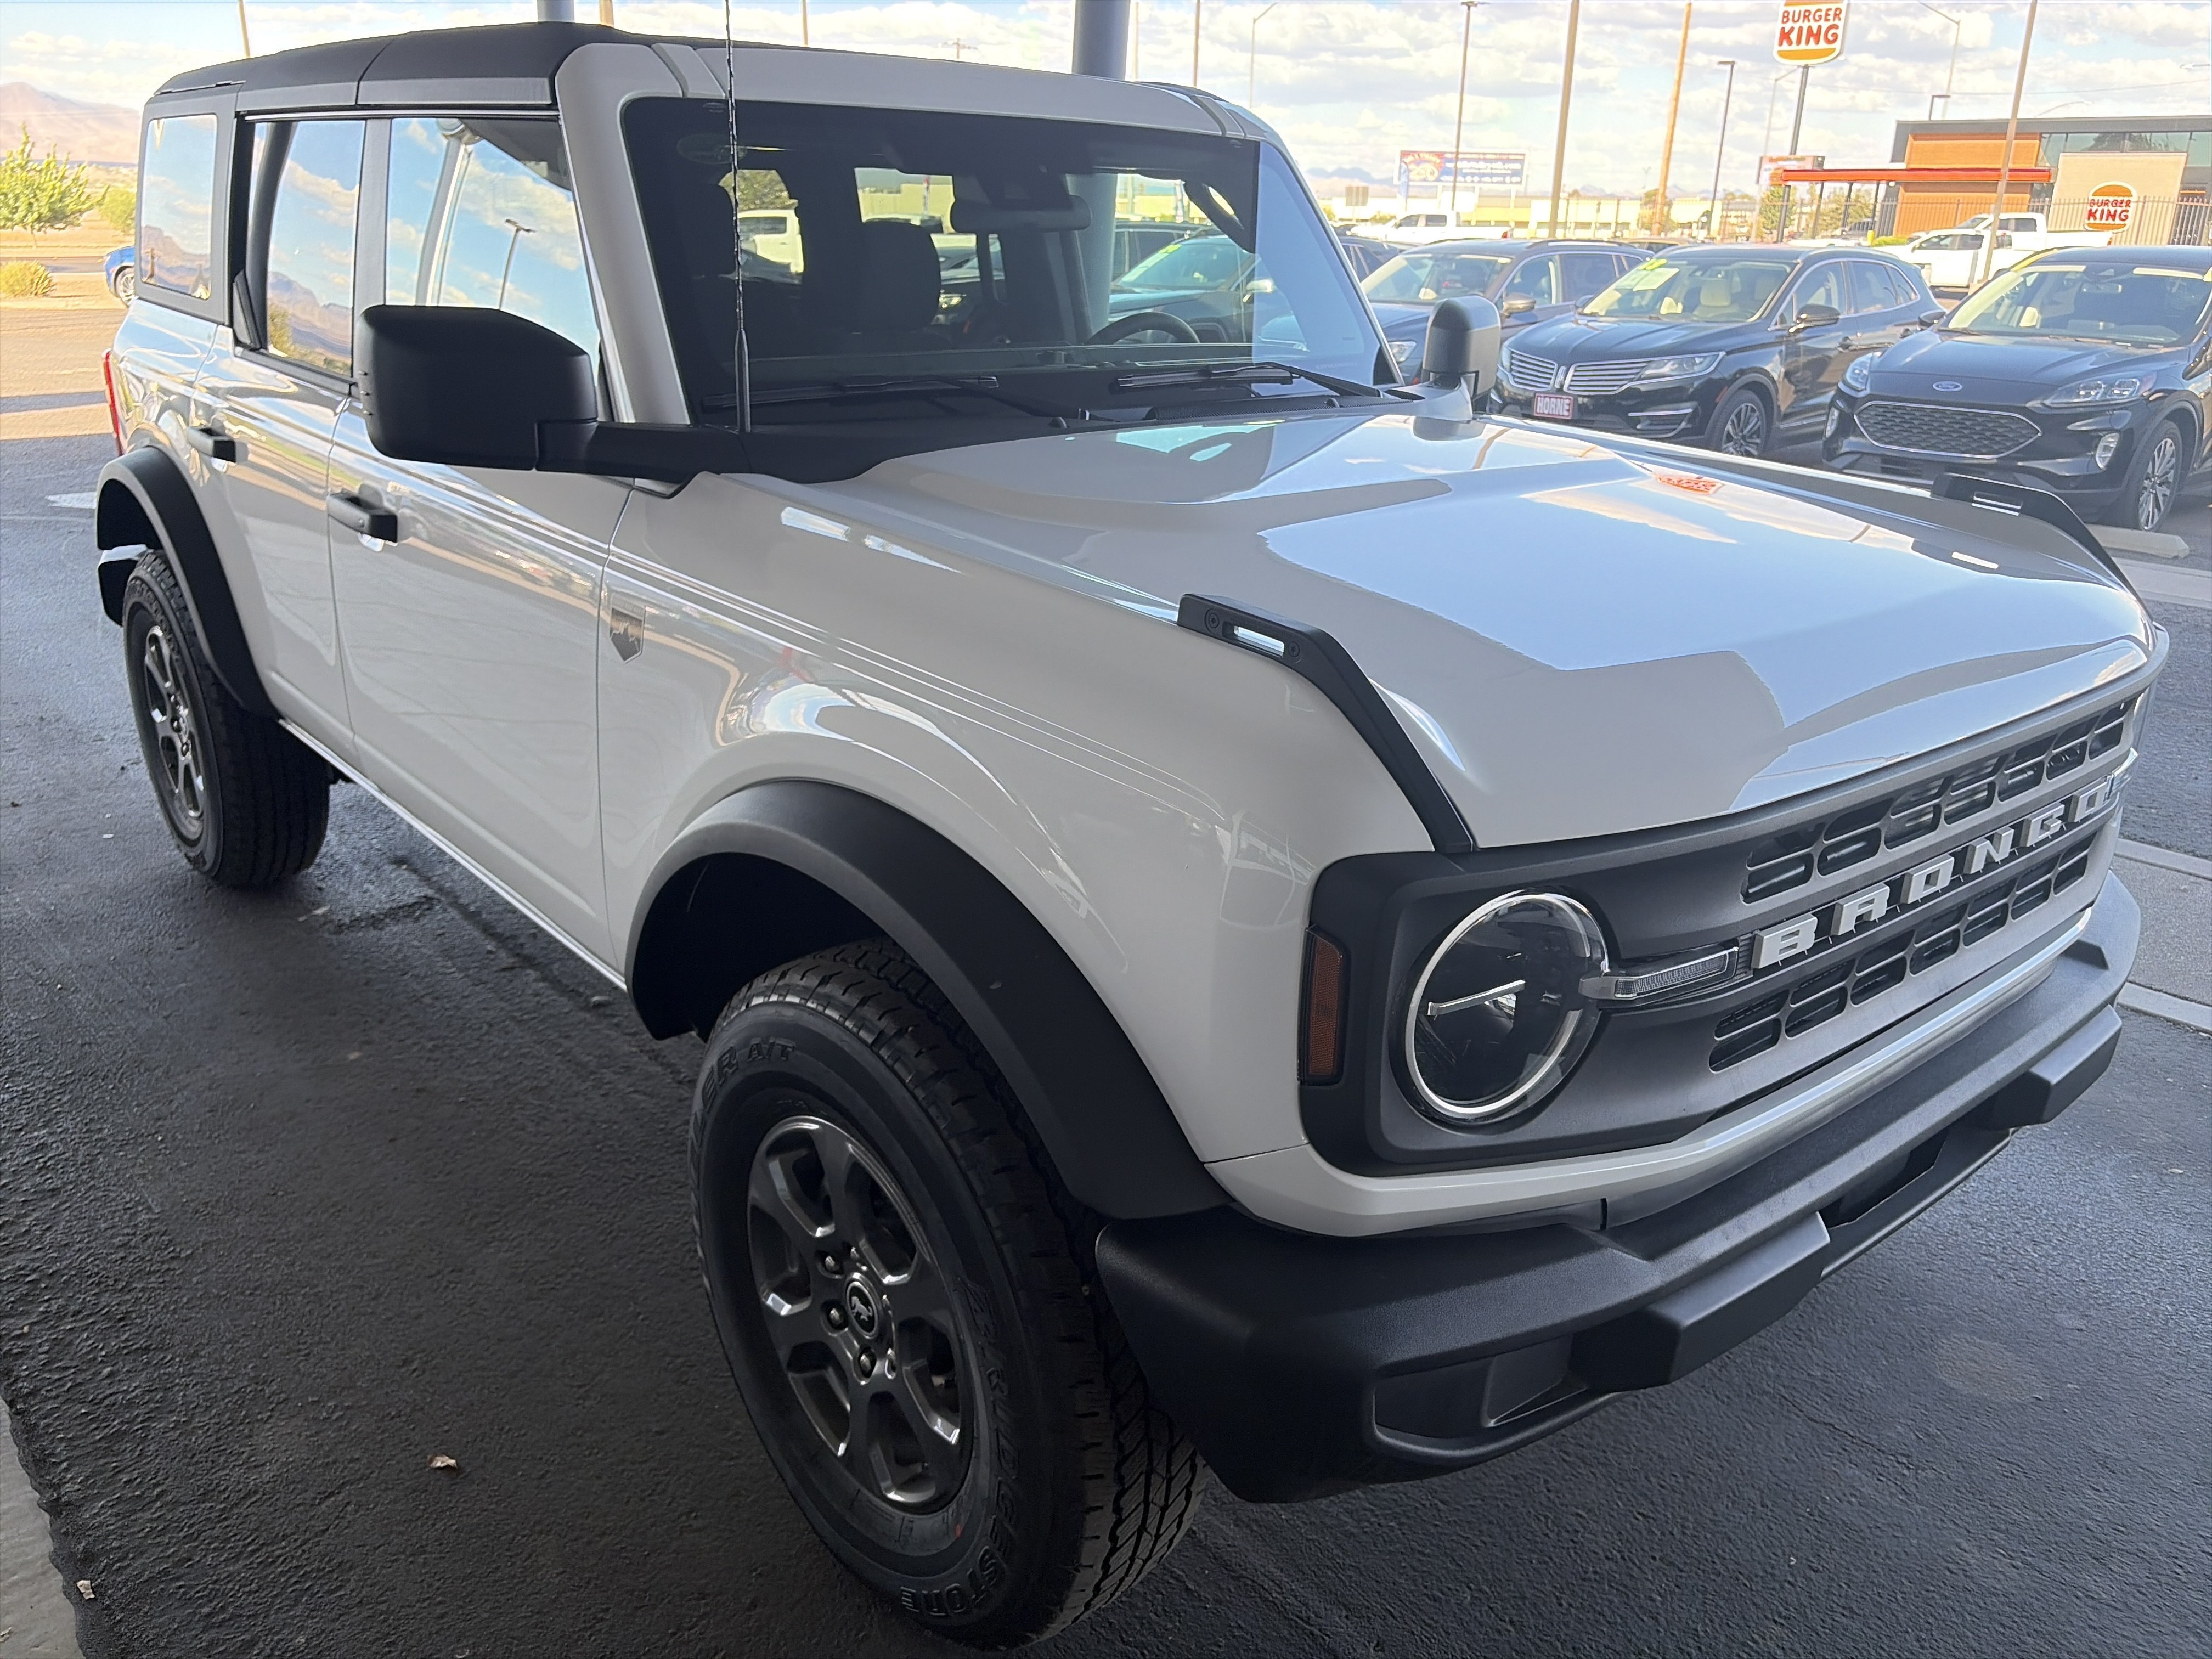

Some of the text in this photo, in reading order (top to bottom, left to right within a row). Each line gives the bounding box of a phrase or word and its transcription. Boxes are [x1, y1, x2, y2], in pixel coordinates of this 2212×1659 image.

[1781, 7, 1842, 24] BURGER
[1778, 24, 1839, 47] KING
[2089, 198, 2131, 208] BURGER
[2087, 208, 2130, 222] KING
[1536, 396, 1570, 416] HORNE
[1752, 779, 2112, 970] BRONCO
[747, 1036, 797, 1062] A/T
